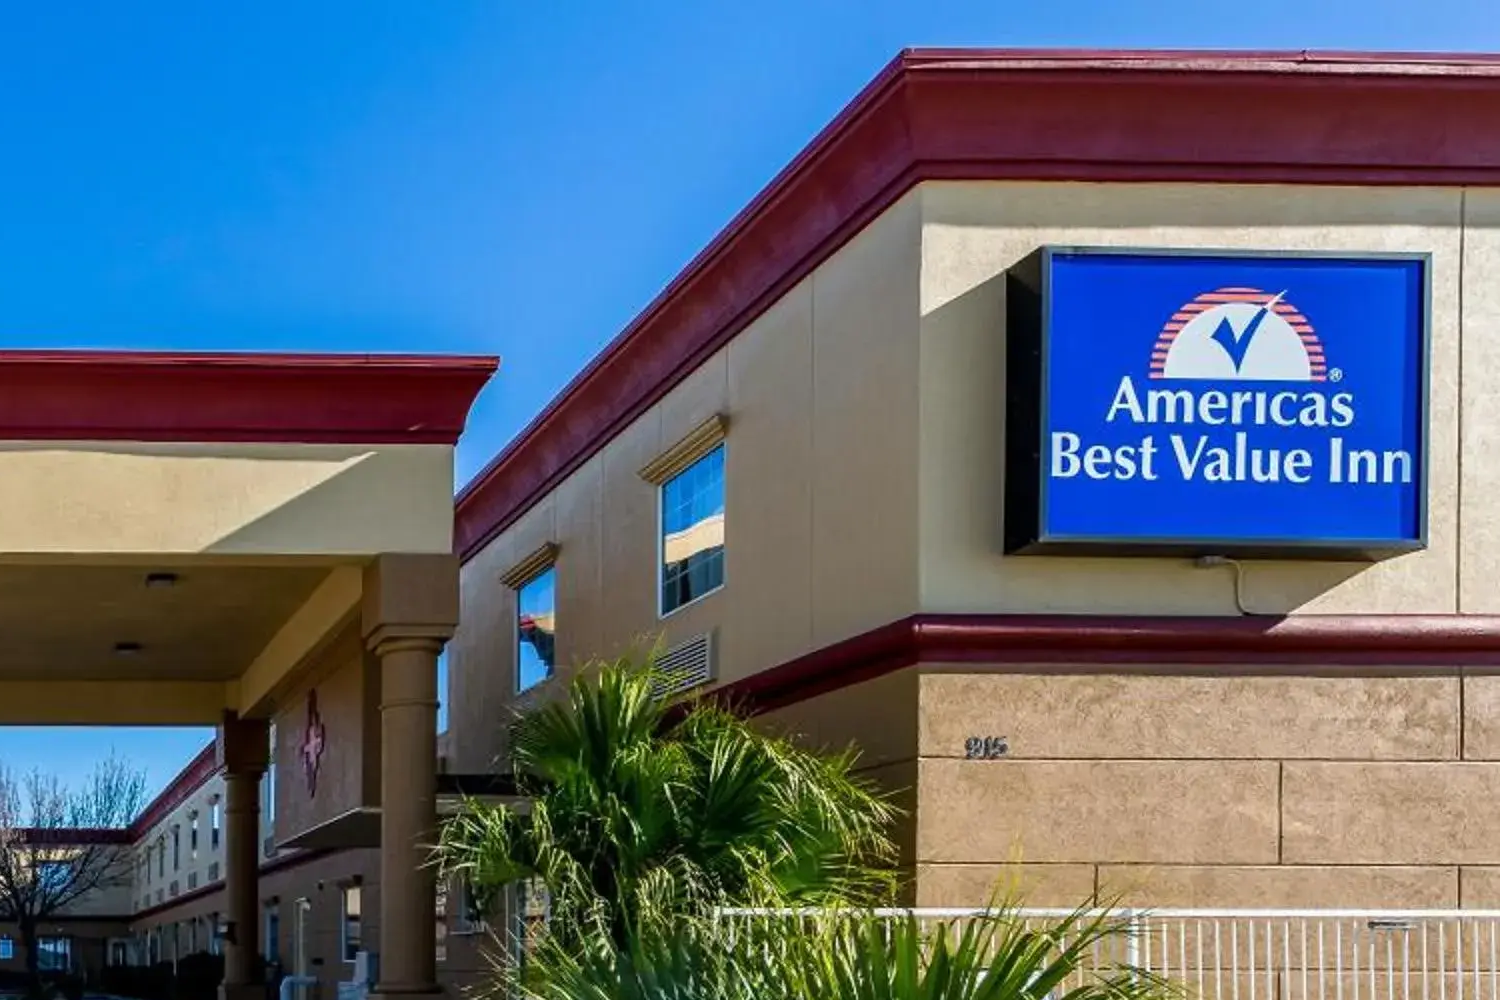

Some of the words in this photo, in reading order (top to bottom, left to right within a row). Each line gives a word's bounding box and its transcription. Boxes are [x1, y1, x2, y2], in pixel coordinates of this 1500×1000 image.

[1105, 375, 1355, 427] Americas
[1051, 431, 1159, 481] Best
[1170, 431, 1313, 483] Value
[1329, 437, 1412, 483] Inn
